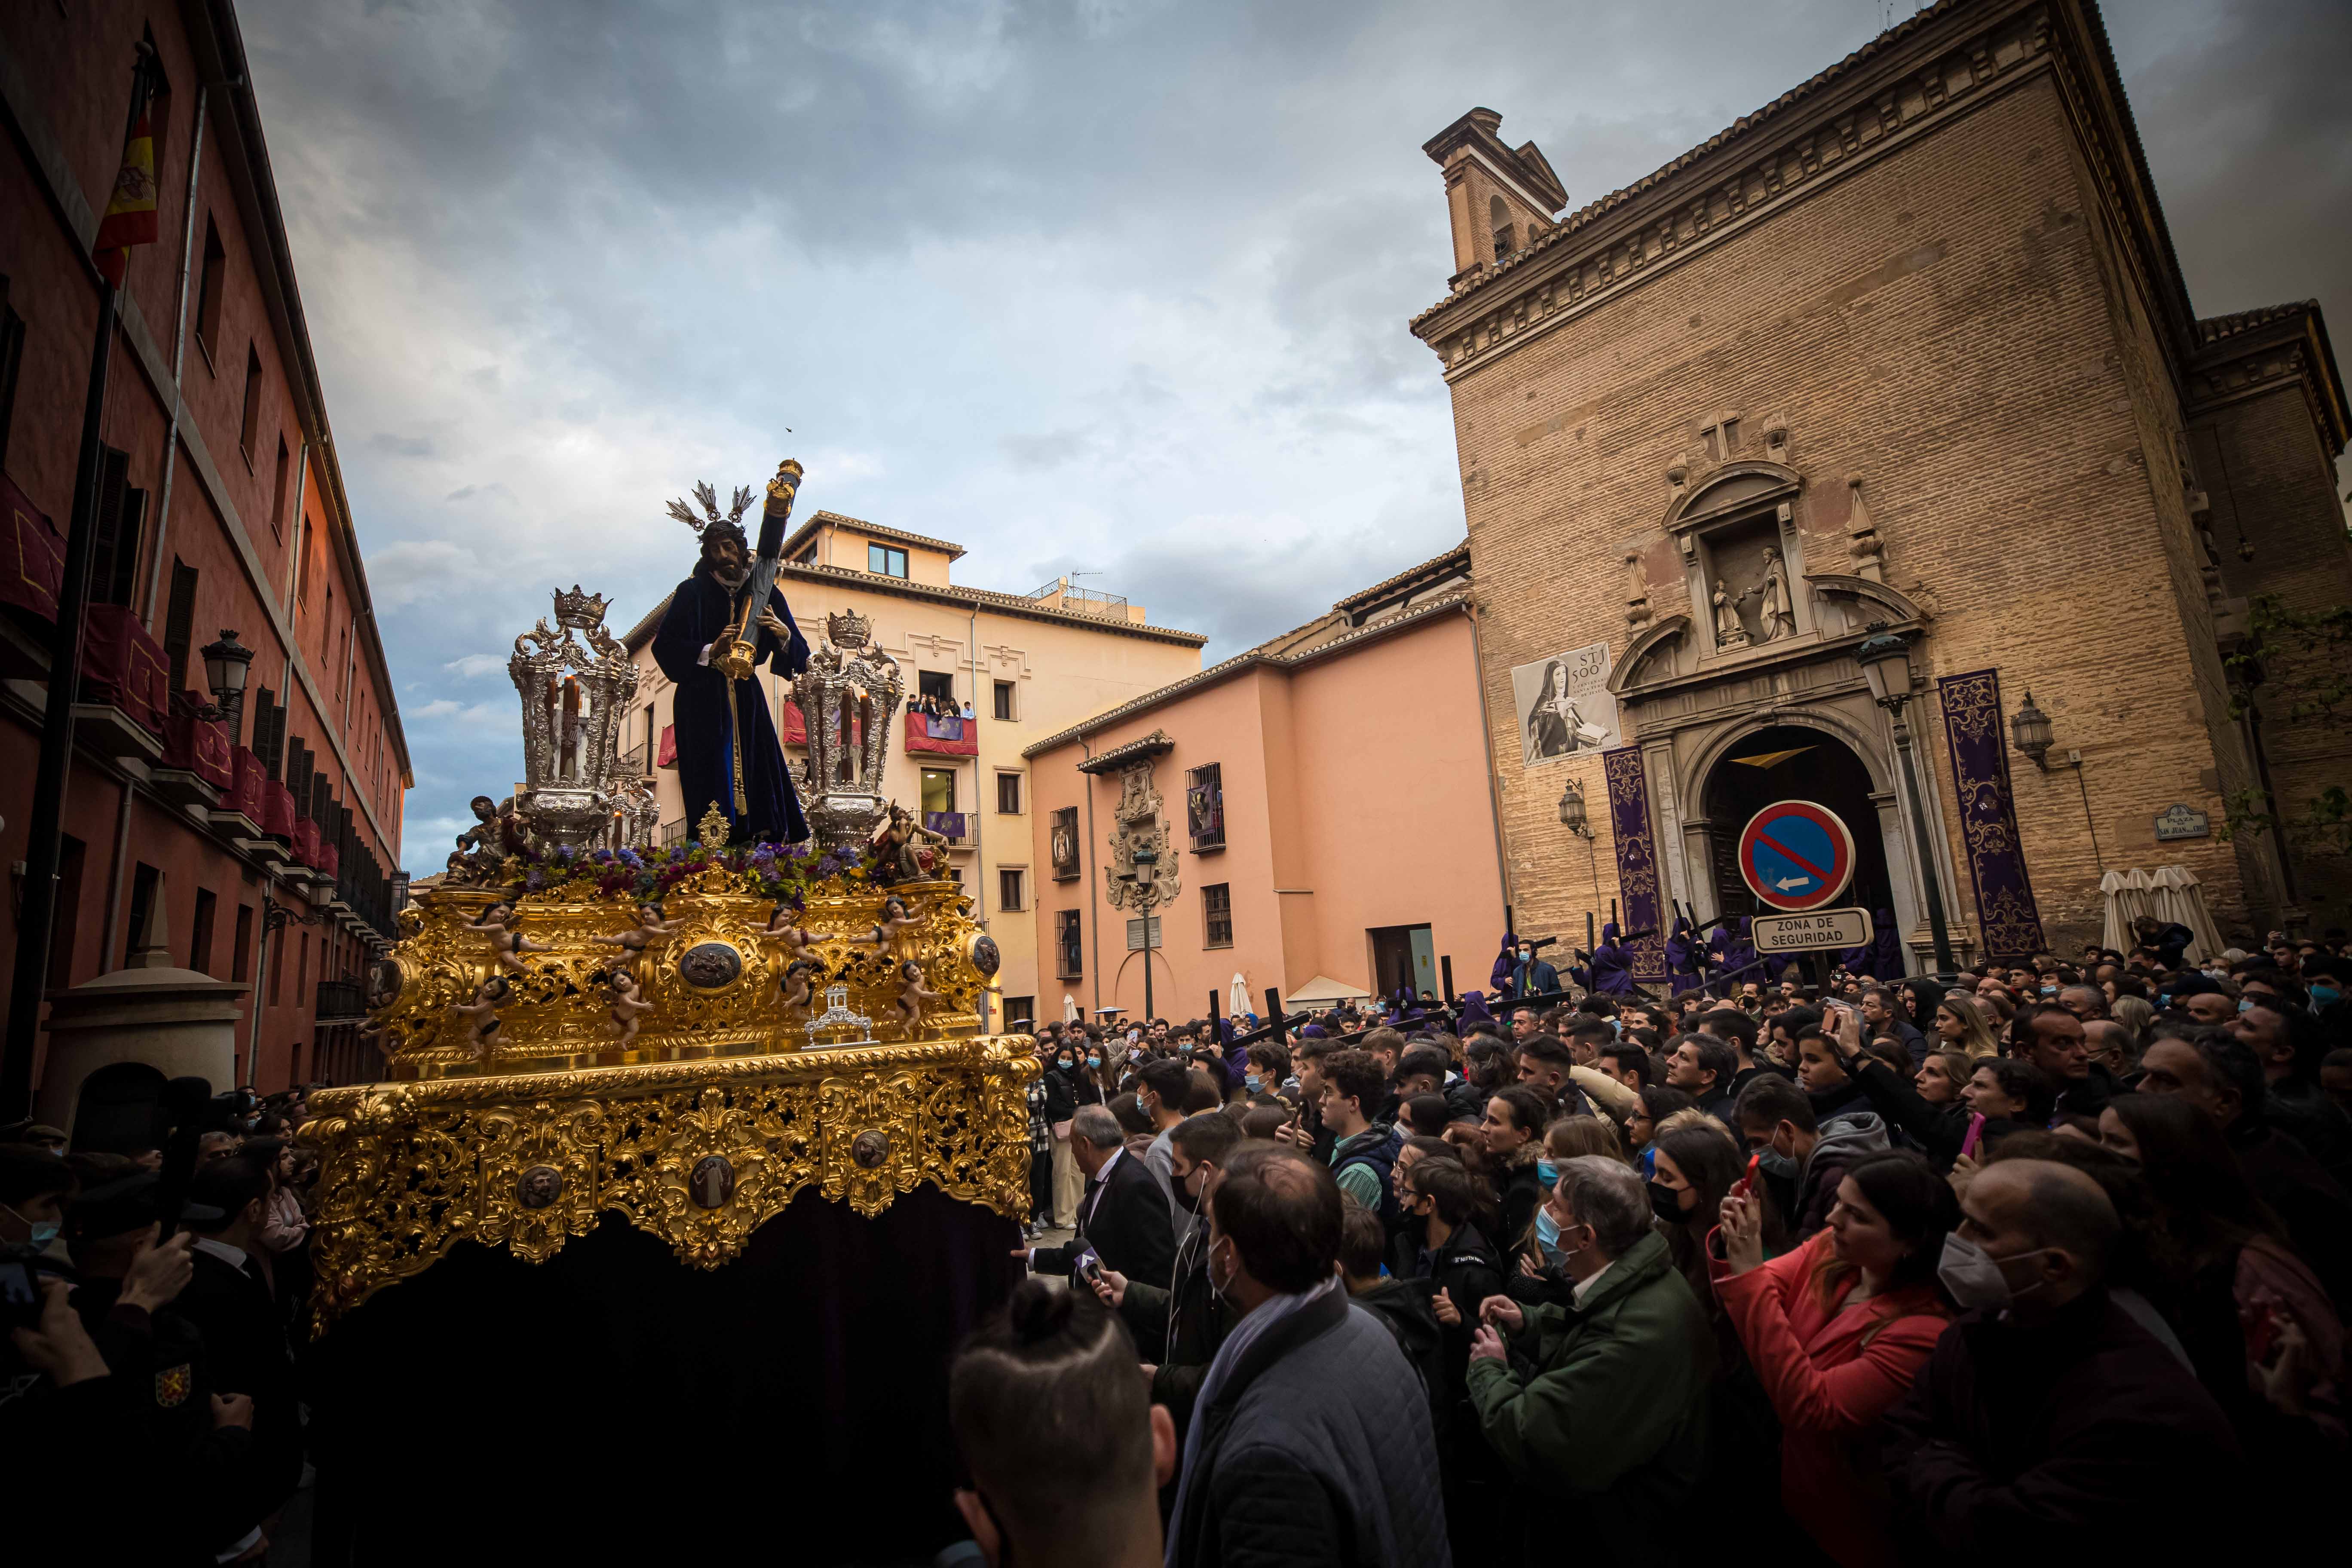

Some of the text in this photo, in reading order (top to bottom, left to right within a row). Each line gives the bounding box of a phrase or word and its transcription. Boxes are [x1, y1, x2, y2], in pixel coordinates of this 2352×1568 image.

[1580, 649, 1604, 666] STJ
[1572, 665, 1599, 684] 500
[1777, 917, 1834, 931] ZONA DE
[1772, 931, 1843, 946] SEGURIDAD
